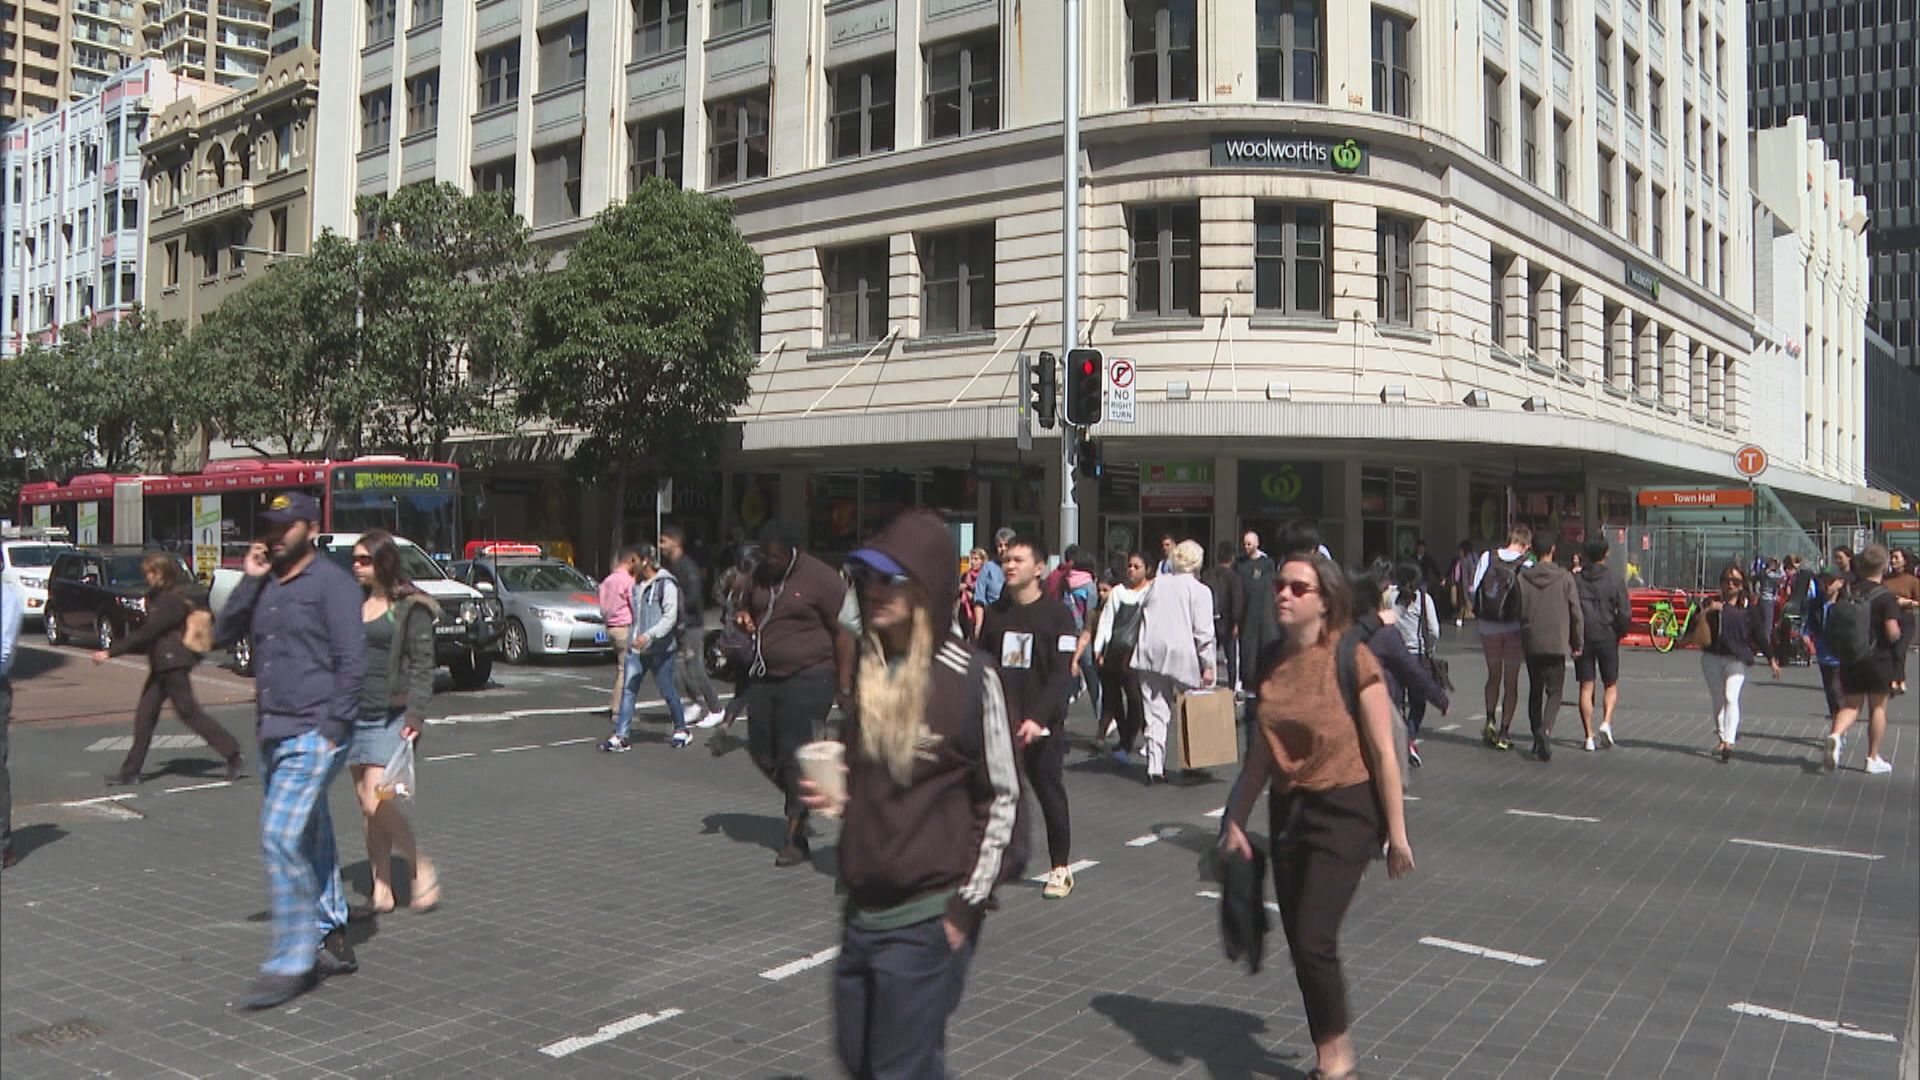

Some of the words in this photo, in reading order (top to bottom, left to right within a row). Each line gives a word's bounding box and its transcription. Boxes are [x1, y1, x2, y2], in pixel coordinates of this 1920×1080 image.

[1226, 137, 1327, 161] Woolworths
[1114, 389, 1129, 400] NO
[1111, 401, 1133, 410] RIGHT
[1111, 410, 1132, 419] TURN
[1743, 453, 1758, 471] T
[1673, 493, 1697, 503] Town
[1698, 493, 1716, 503] Hall
